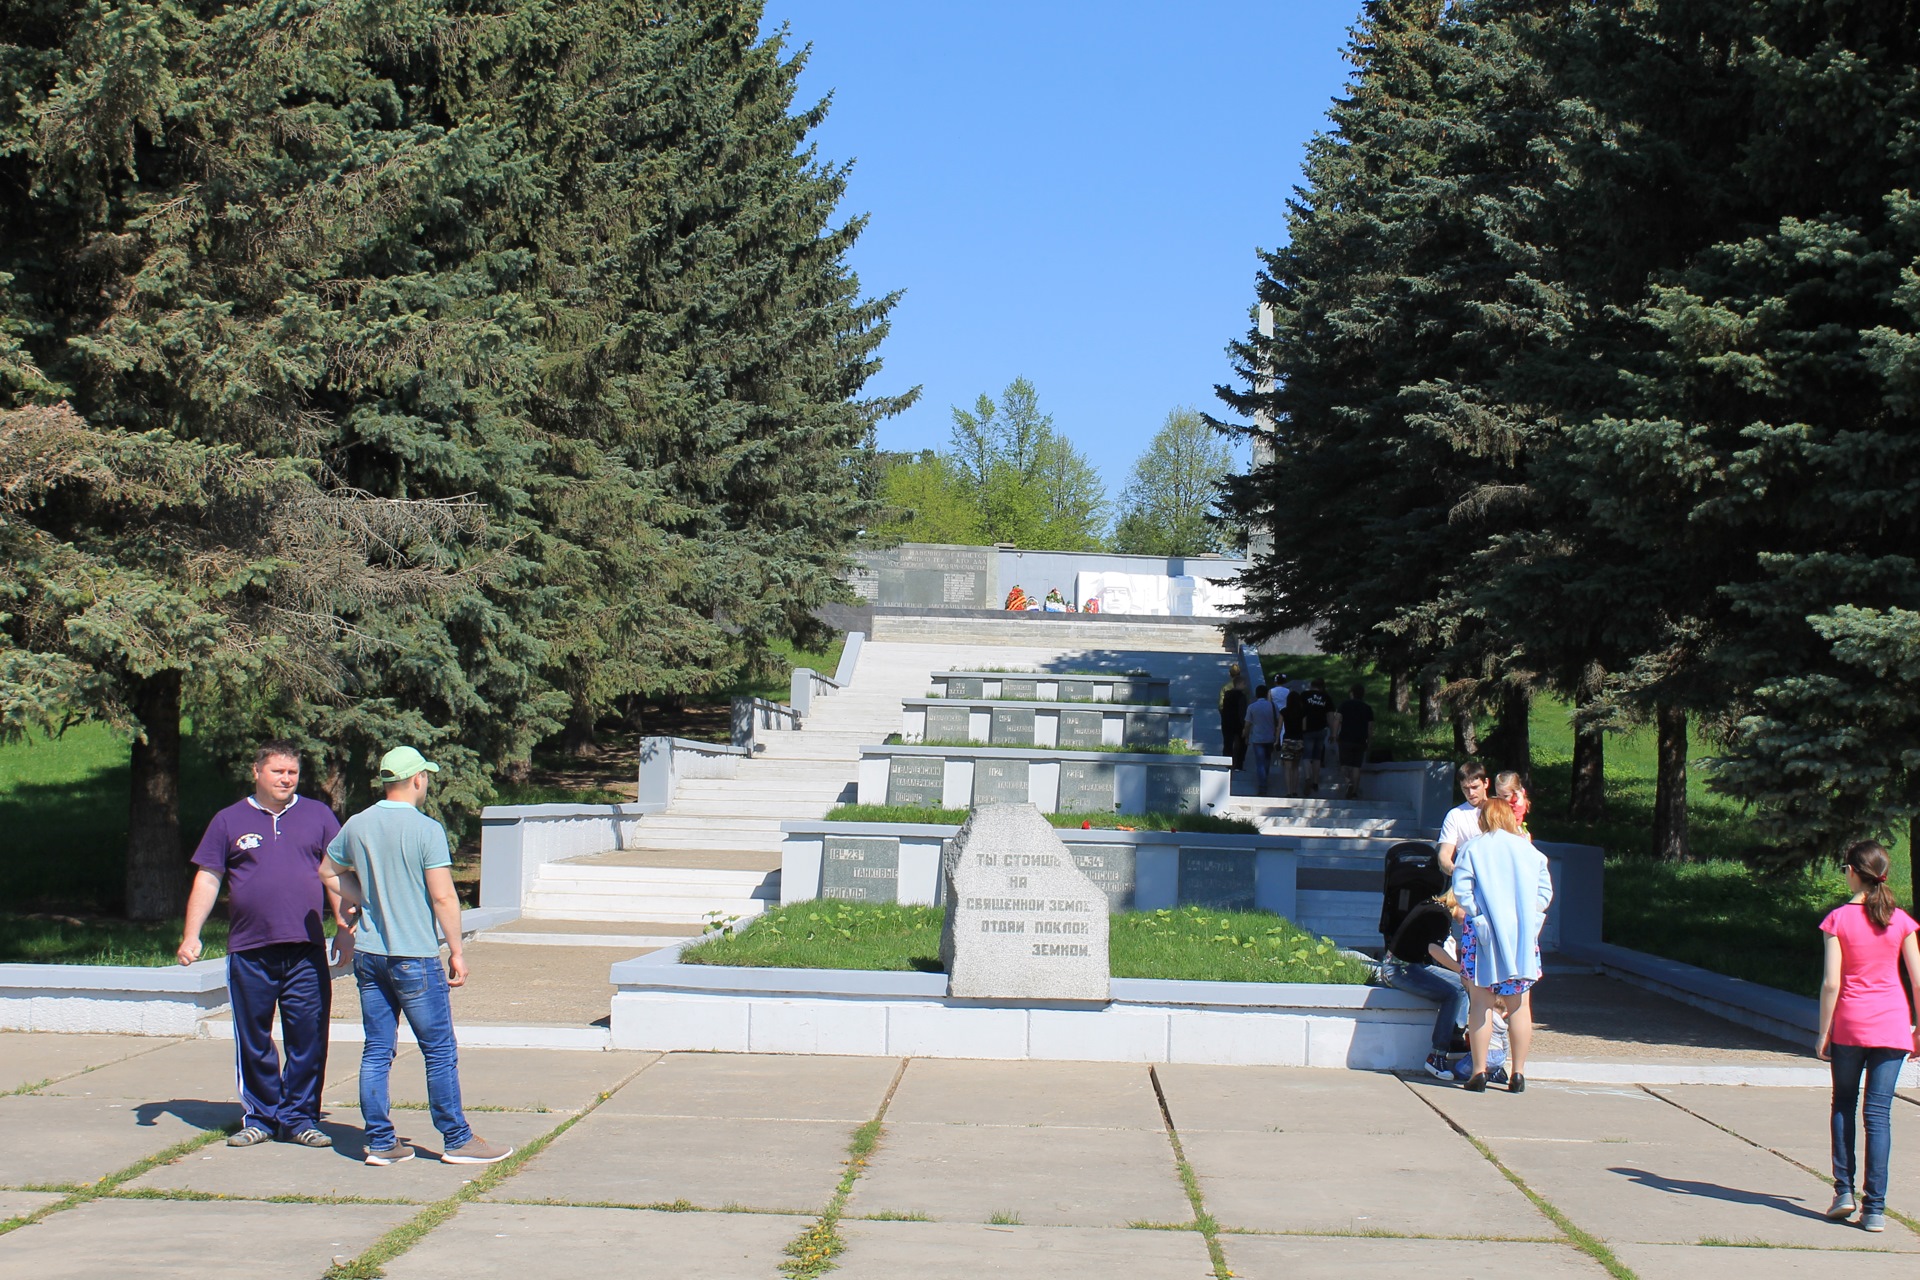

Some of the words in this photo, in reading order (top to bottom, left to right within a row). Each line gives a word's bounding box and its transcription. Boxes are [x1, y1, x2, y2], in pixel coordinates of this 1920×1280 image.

[976, 853, 997, 866] ТЫ
[1003, 854, 1062, 867] СТОИШЬ
[854, 867, 899, 878] ТАНКОВЫЕ
[1009, 876, 1028, 889] НА
[822, 886, 867, 899] БРИГАДЫ
[1034, 921, 1090, 935] ПОКЛОН
